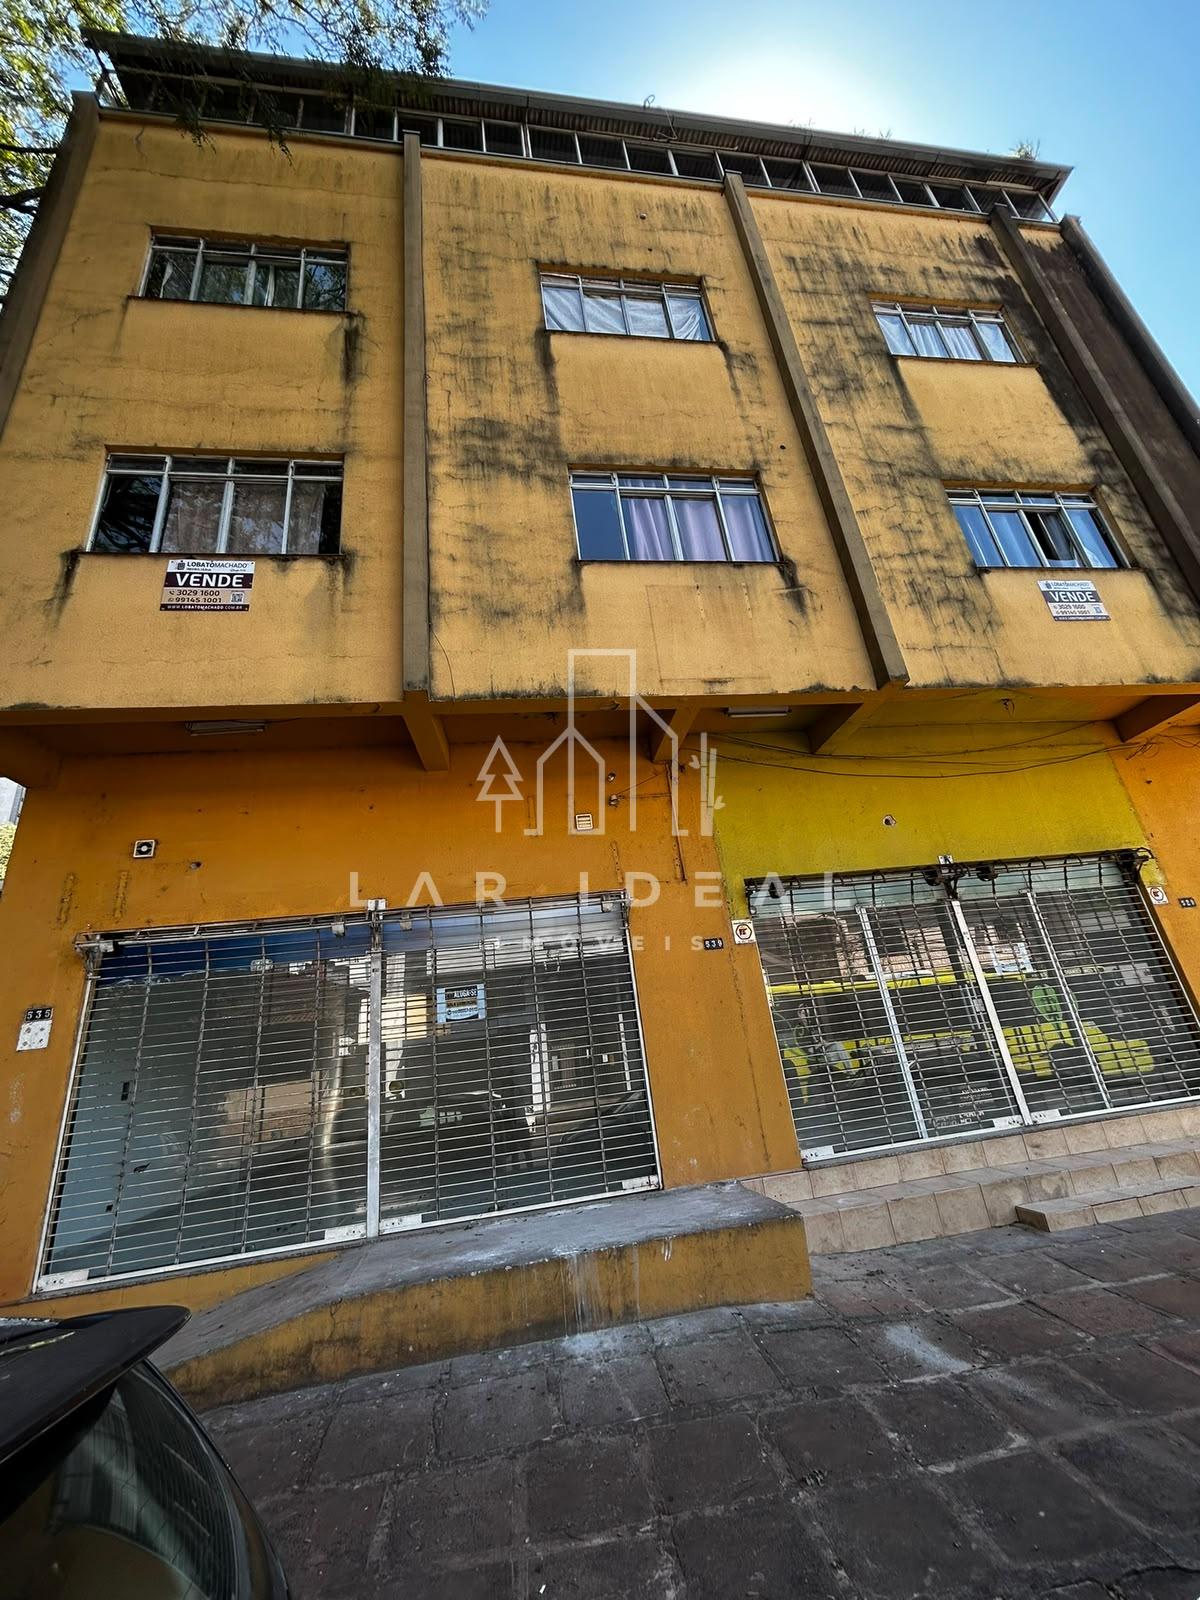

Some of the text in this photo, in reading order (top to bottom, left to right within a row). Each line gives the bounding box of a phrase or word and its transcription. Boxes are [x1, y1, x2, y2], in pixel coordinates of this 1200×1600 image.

[176, 573, 244, 587] VENDE
[176, 589, 198, 597] 3029
[1049, 591, 1097, 602] VENDE
[26, 1009, 51, 1020] 535
